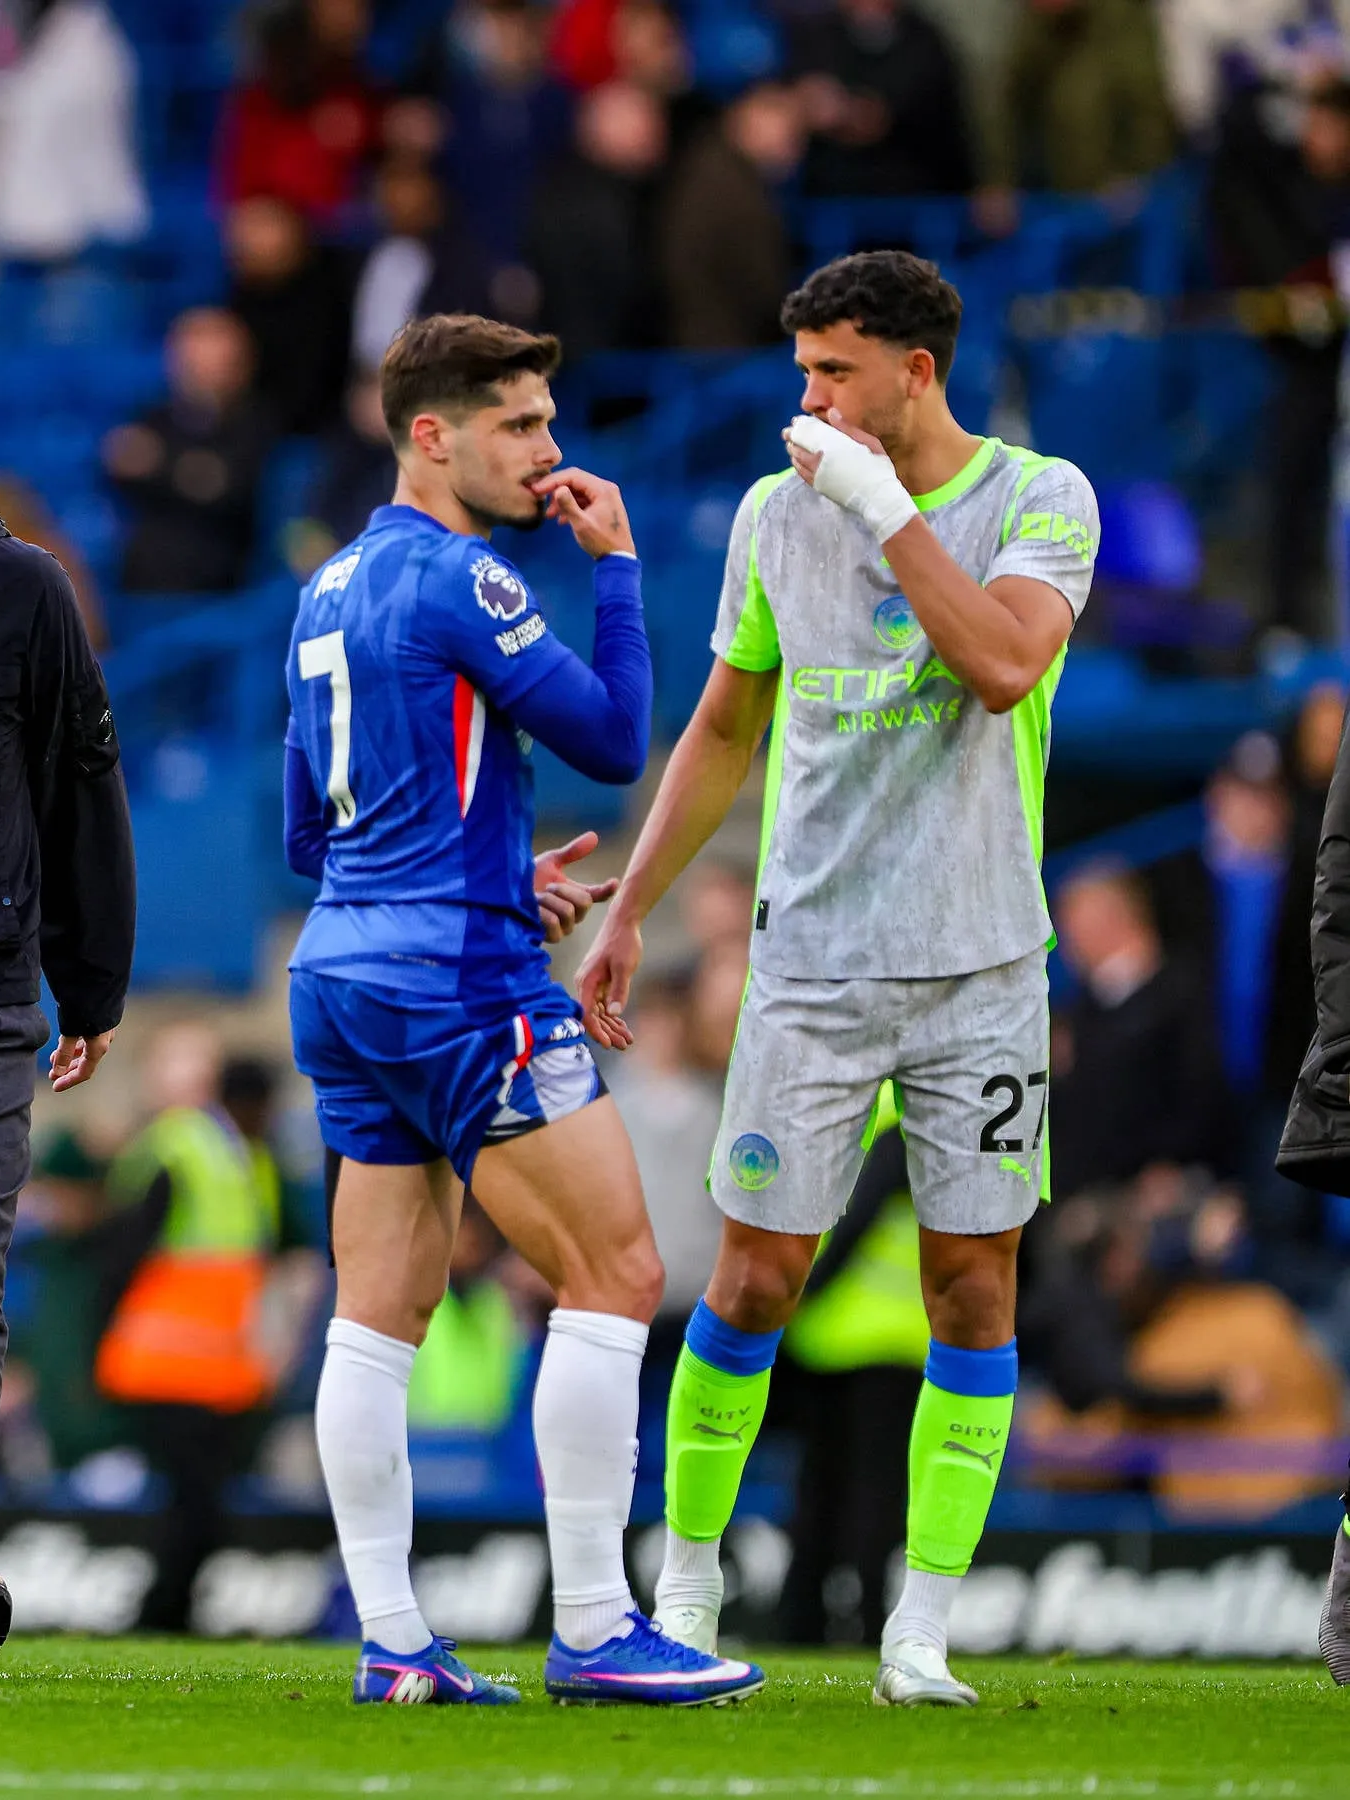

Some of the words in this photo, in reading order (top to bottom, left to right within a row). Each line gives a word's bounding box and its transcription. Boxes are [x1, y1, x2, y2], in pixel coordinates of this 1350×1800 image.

[792, 656, 962, 701] ETIHA
[299, 630, 356, 828] 7
[837, 697, 961, 735] AIRWAYS
[979, 1070, 1048, 1154] 27
[700, 1405, 752, 1421] CITY
[950, 1423, 1002, 1439] CITY
